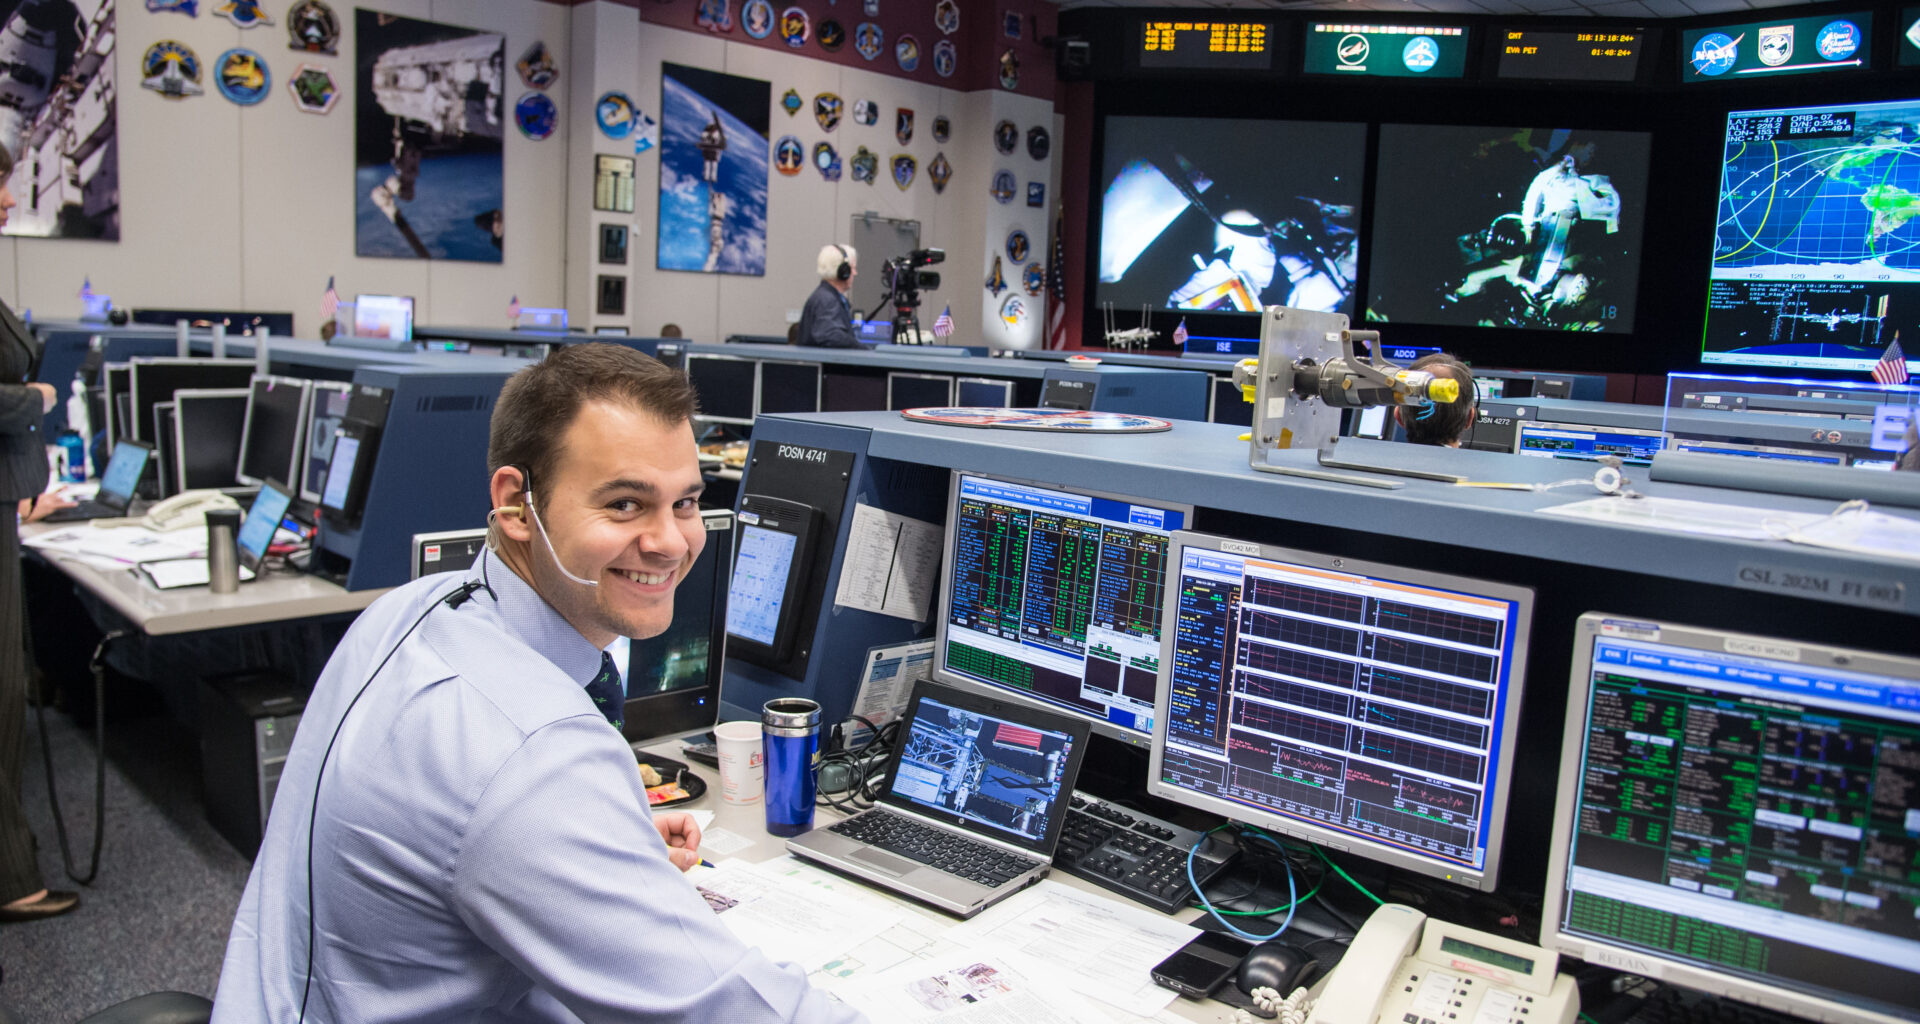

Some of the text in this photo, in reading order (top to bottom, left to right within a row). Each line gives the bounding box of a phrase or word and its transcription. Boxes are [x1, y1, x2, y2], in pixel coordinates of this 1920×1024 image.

[1506, 46, 1520, 54] EVA
[1523, 46, 1538, 54] PET
[1696, 49, 1735, 60] NASA
[1820, 113, 1833, 121] 07
[1729, 118, 1748, 126] LAT
[1790, 120, 1812, 128] D/N:
[1729, 123, 1748, 131] ALT
[1727, 134, 1745, 142] INC
[1753, 134, 1774, 142] 51.7
[1600, 305, 1616, 319] 18
[1216, 341, 1232, 352] ISE
[1394, 349, 1416, 359] ADCO
[1493, 417, 1511, 426] 4272
[778, 444, 827, 463] POSN 4741
[1739, 567, 1775, 584] CSL
